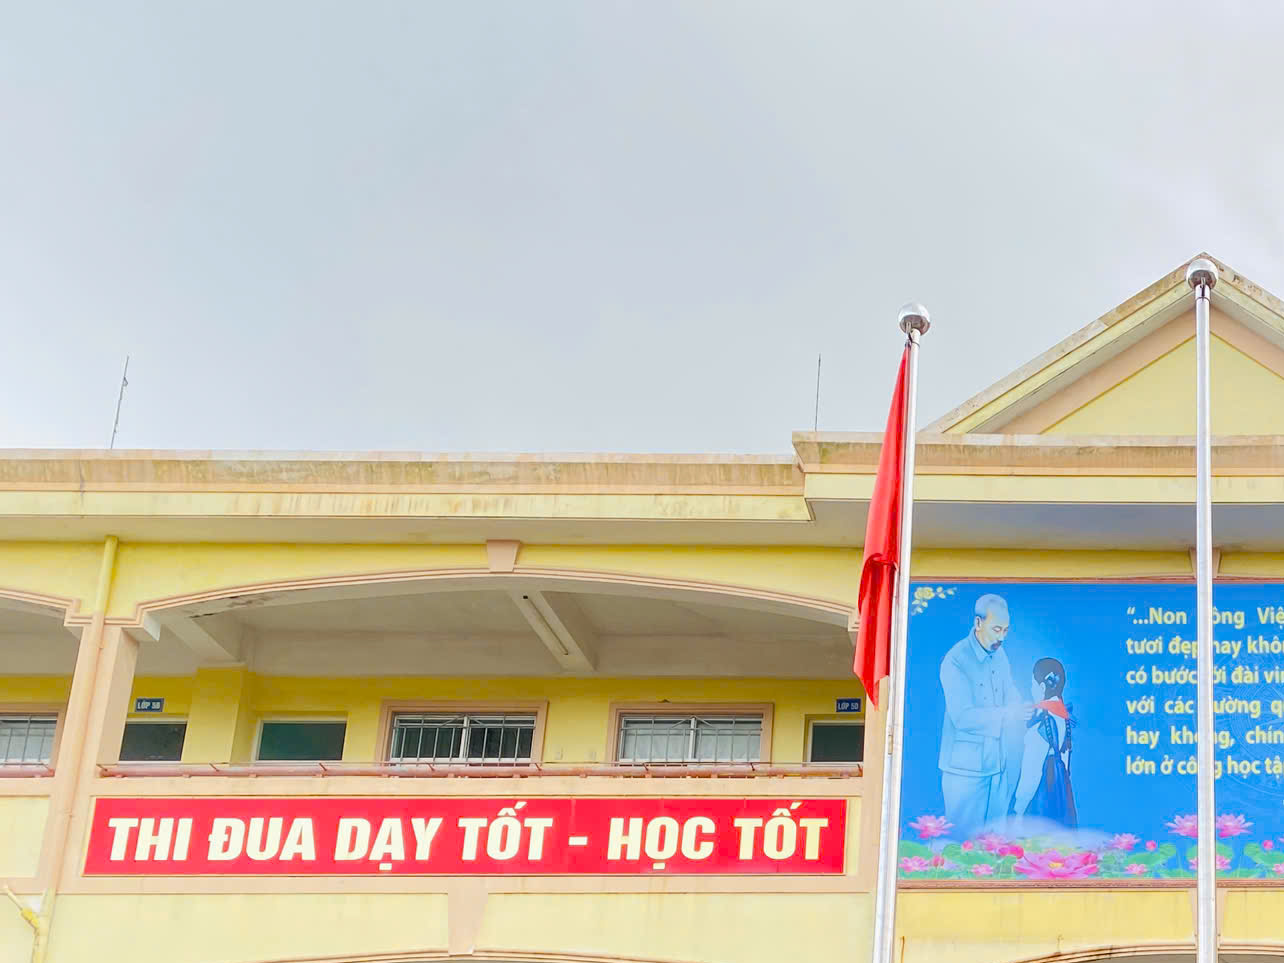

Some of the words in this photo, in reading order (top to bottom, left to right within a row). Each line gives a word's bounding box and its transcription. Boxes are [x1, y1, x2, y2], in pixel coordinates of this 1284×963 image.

[1213, 605, 1245, 629] ông
[1126, 635, 1163, 654] tươi
[1126, 665, 1147, 684] có
[1231, 665, 1258, 684] đài
[1126, 696, 1155, 714] với
[1165, 696, 1194, 714] các
[1213, 696, 1261, 718] ường
[1126, 726, 1160, 749] hay
[1170, 726, 1235, 749] khg,
[1126, 756, 1156, 775] lớn
[1160, 754, 1174, 774] ở
[1177, 756, 1222, 779] côg
[1227, 756, 1261, 779] học
[108, 817, 193, 861] THI
[207, 817, 316, 861] ĐUA
[334, 817, 443, 871] DẠY
[458, 801, 553, 861] TỐT
[568, 836, 588, 846] -
[607, 816, 716, 870] HỌC
[734, 801, 829, 861] TỐT
